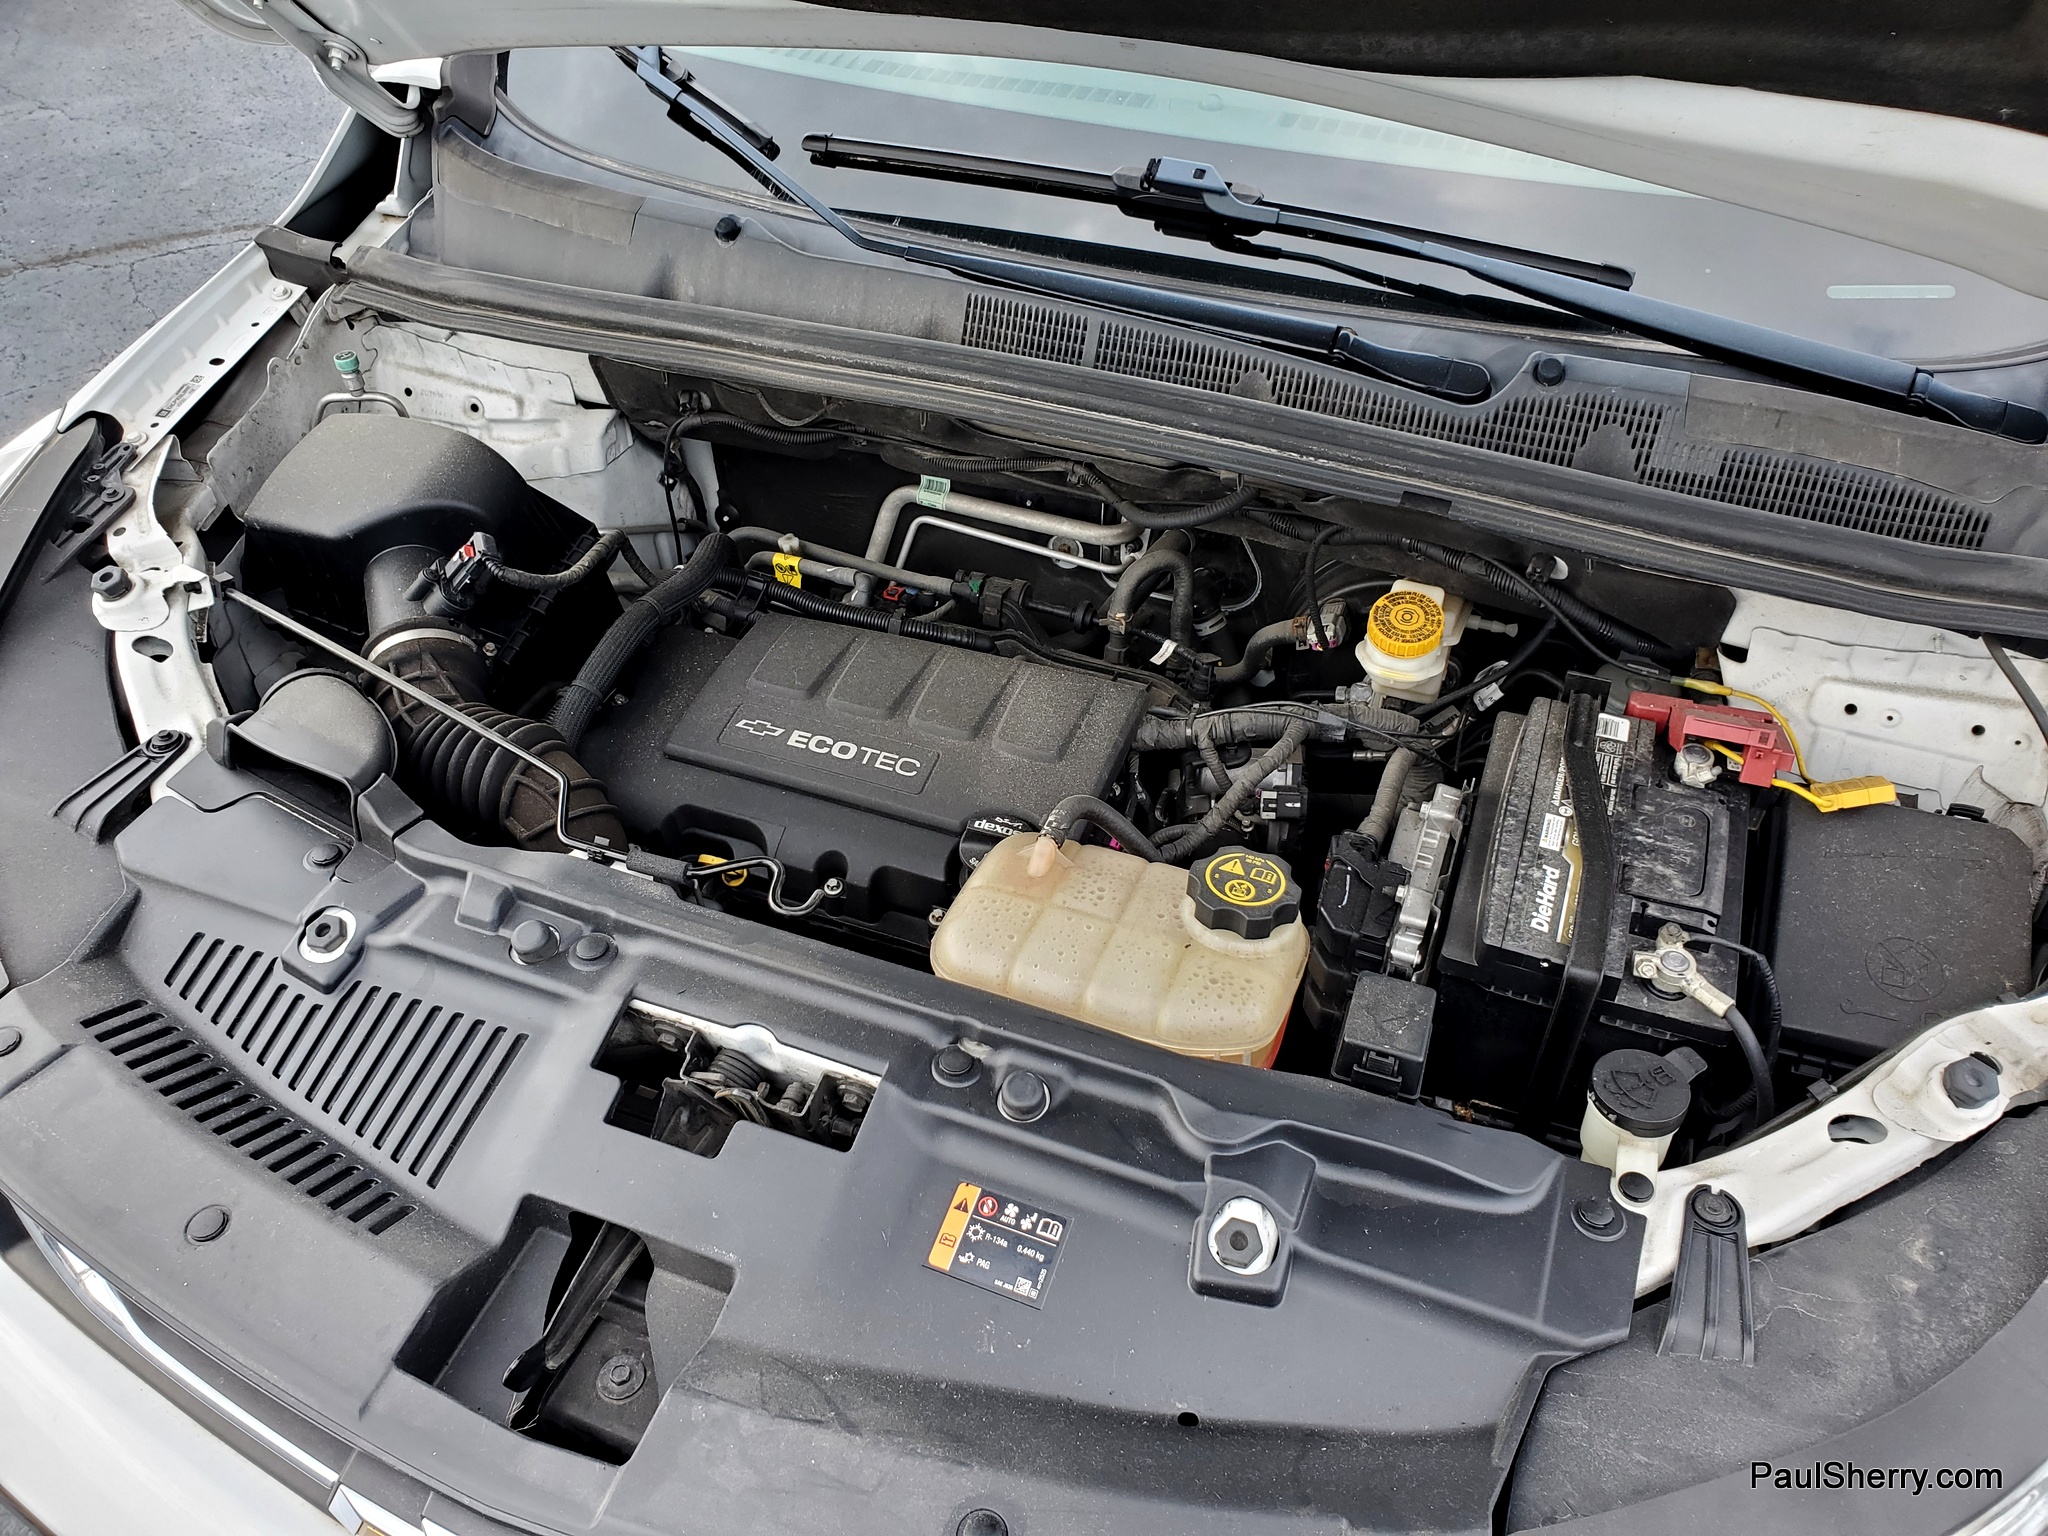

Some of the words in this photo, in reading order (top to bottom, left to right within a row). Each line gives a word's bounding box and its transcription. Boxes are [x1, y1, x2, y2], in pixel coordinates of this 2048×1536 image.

[786, 730, 921, 777] ECOTEC
[969, 857, 979, 867] SA
[1530, 864, 1561, 933] DieHard
[1000, 1215, 1016, 1226] AUTO
[985, 1233, 1009, 1248] R-134a
[1017, 1245, 1035, 1258] 0.440
[1035, 1251, 1044, 1262] kg
[976, 1258, 991, 1270] PAG
